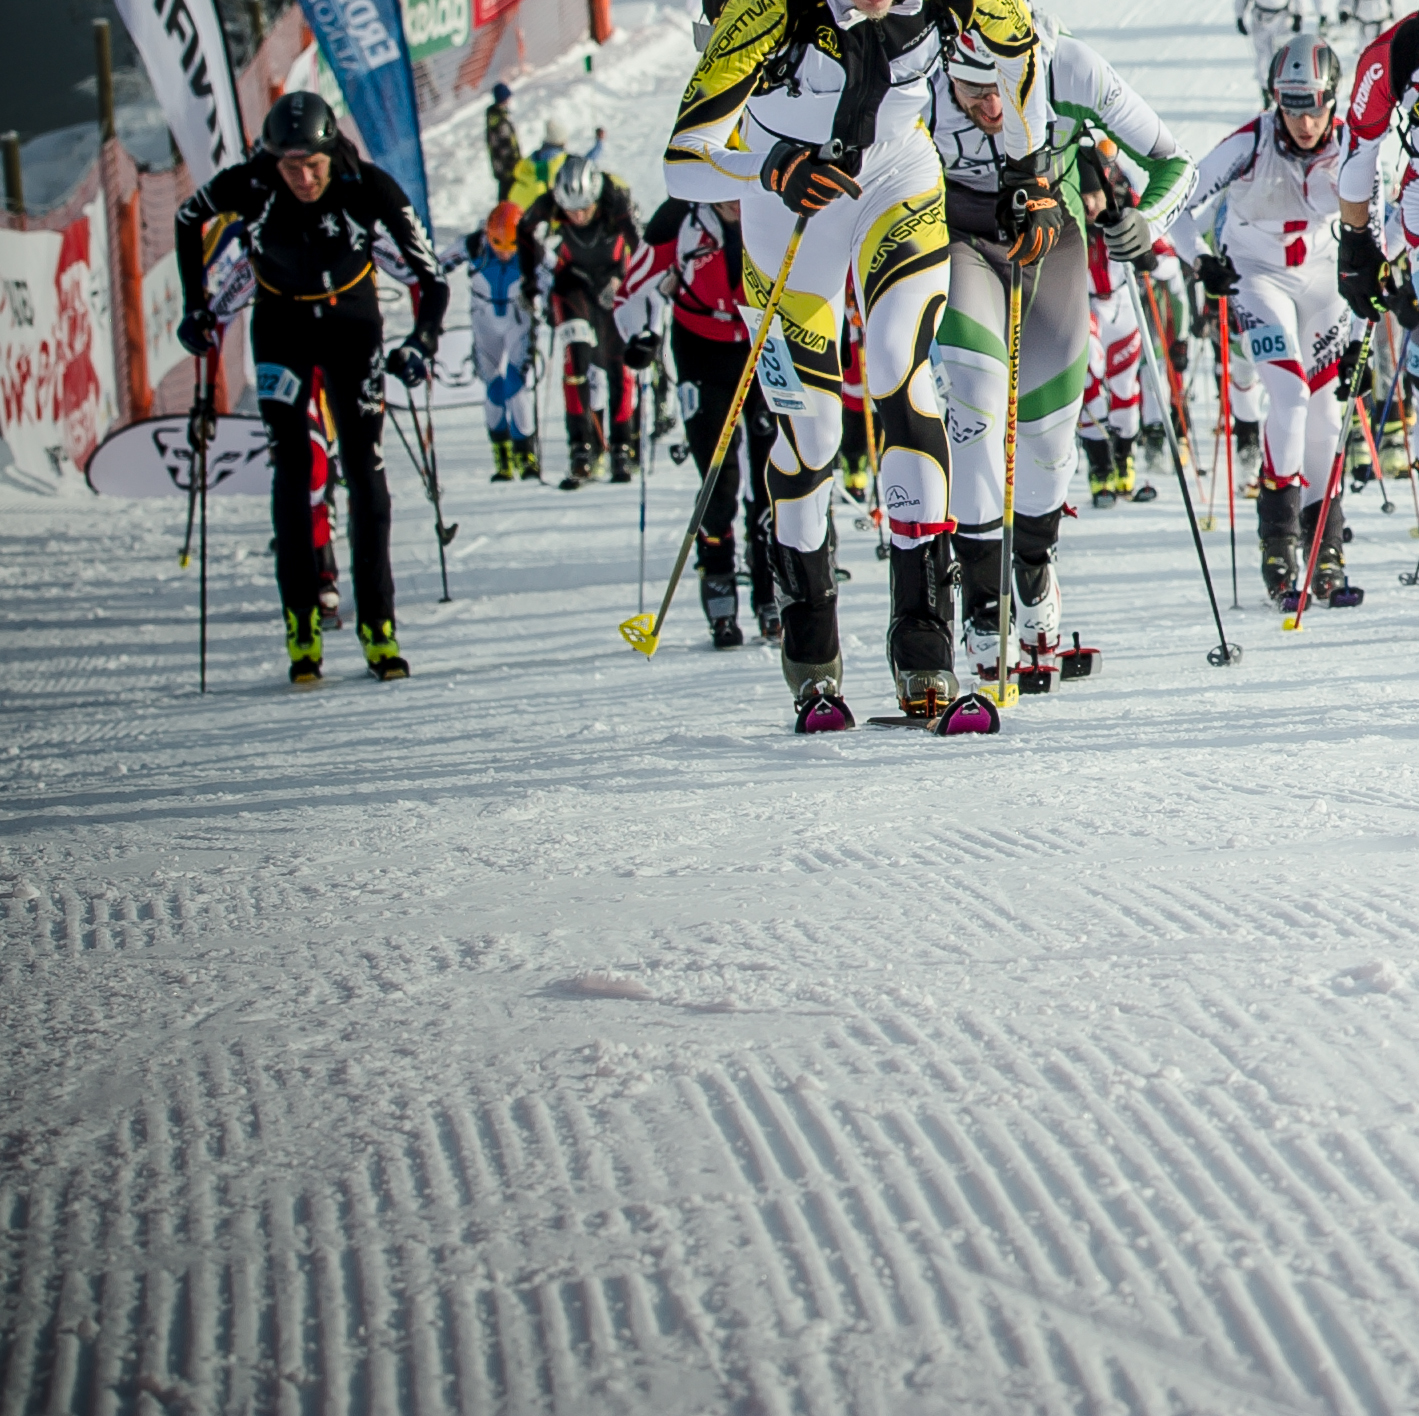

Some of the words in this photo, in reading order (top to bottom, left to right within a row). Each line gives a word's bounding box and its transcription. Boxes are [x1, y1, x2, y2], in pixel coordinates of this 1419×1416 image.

[1351, 62, 1384, 121] ATOMIC
[760, 338, 788, 389] 023
[1010, 322, 1022, 392] carbon
[1251, 334, 1287, 357] 005
[1007, 396, 1018, 445] RACE
